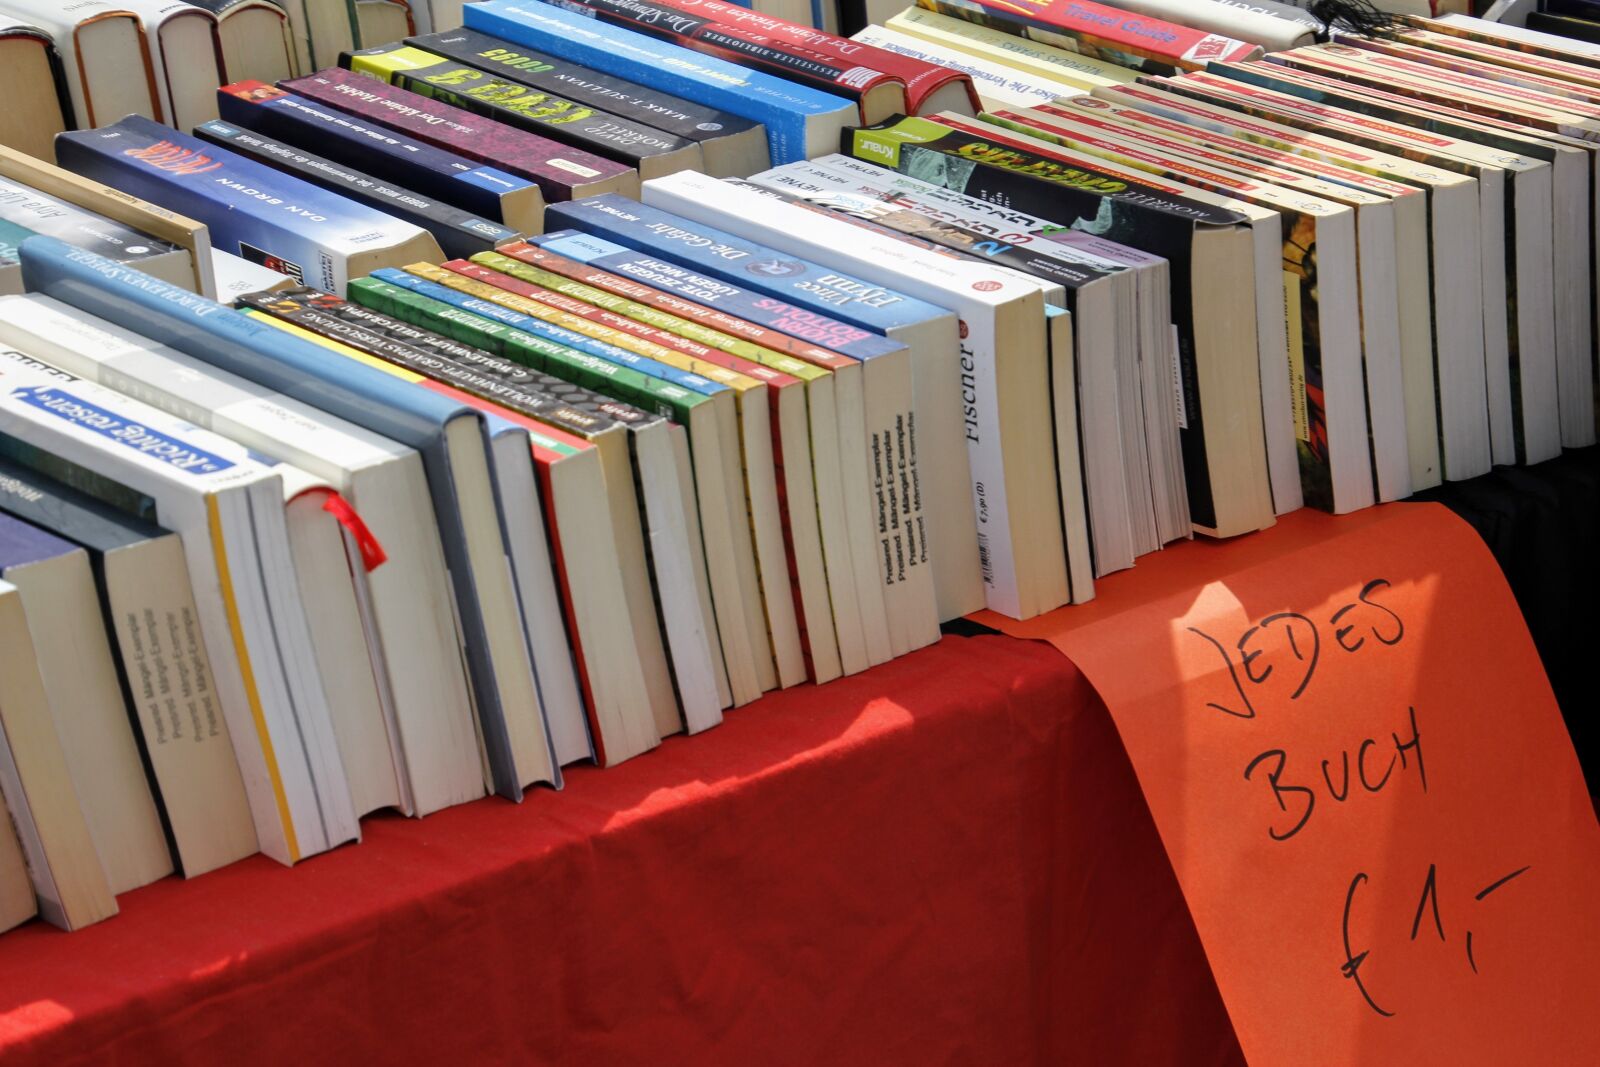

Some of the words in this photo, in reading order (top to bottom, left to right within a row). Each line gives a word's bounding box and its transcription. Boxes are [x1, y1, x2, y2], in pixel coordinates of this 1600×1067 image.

[652, 15, 700, 31] Das
[722, 8, 780, 29] Frieden
[1053, 4, 1130, 25] Travel
[1111, 20, 1190, 42] Guide
[776, 26, 829, 43] kleine
[698, 31, 842, 75] BESTSELLER-BIBLIOTHEK
[822, 39, 859, 54] Der
[997, 42, 1045, 57] SPARKS
[476, 48, 557, 73] 66095
[1044, 55, 1103, 74] NICHOLAS
[329, 84, 384, 101] Hobbit
[551, 74, 631, 98] SULLIVAN
[1006, 82, 1031, 92] Die
[373, 100, 421, 115] kleine
[412, 112, 446, 124] Der
[640, 103, 691, 119] MARK
[582, 127, 637, 144] DAVID
[595, 123, 674, 148] MORRELL
[121, 139, 225, 177] METEOR
[858, 139, 895, 159] Knaur.
[813, 169, 848, 184] HEYNE
[848, 163, 883, 177] HEYNE
[215, 178, 284, 203] BROWN
[777, 176, 823, 192] HEYNE
[396, 195, 432, 208] ROBERT
[284, 205, 328, 221] DAN
[597, 205, 641, 221] HEYNE
[638, 220, 717, 247] Gefahr
[997, 231, 1033, 246] 3
[702, 243, 752, 260] Die
[968, 239, 1012, 255] 2
[59, 249, 125, 278] SPIEGEL
[631, 258, 688, 277] NICHT
[117, 272, 167, 294] EINEN
[587, 273, 651, 296] INTRUDER
[612, 263, 686, 287] ZEUGEN
[678, 275, 740, 296] LÜGEN
[675, 284, 725, 300] TOTE
[786, 280, 857, 304] Vince
[806, 273, 906, 308] Flynn
[157, 289, 216, 315] DURCH
[462, 299, 525, 322] INTRUDER
[531, 290, 595, 314] INTRUDER
[652, 295, 710, 315] Hohlbein
[301, 313, 389, 347] VERSUCHUNG
[384, 322, 424, 338] KILLT
[439, 309, 503, 332] INTRUDER
[598, 313, 655, 334] Hohlbein
[708, 314, 766, 335] Wolfgang
[749, 298, 873, 340] BOTTOLVS
[505, 331, 564, 353] Hohlbein
[529, 321, 587, 341] Hohlbein
[679, 324, 740, 346] Wolfgang
[584, 340, 642, 361] Wolfgang
[614, 334, 671, 355] Wolfgang
[652, 331, 713, 354] Wolfgang
[386, 345, 445, 368] GRAPPAS
[559, 350, 622, 373] Wolfgang
[32, 390, 117, 433] reisen«
[112, 424, 216, 475] »Richtig
[895, 413, 911, 514] Mängel-Exemplar
[872, 432, 888, 533] Mängel-Exemplar
[883, 429, 899, 529] Mängel-Exemplar
[1187, 578, 1404, 719] JEDES
[1244, 706, 1427, 842] BUCH
[1341, 872, 1395, 1018] €
